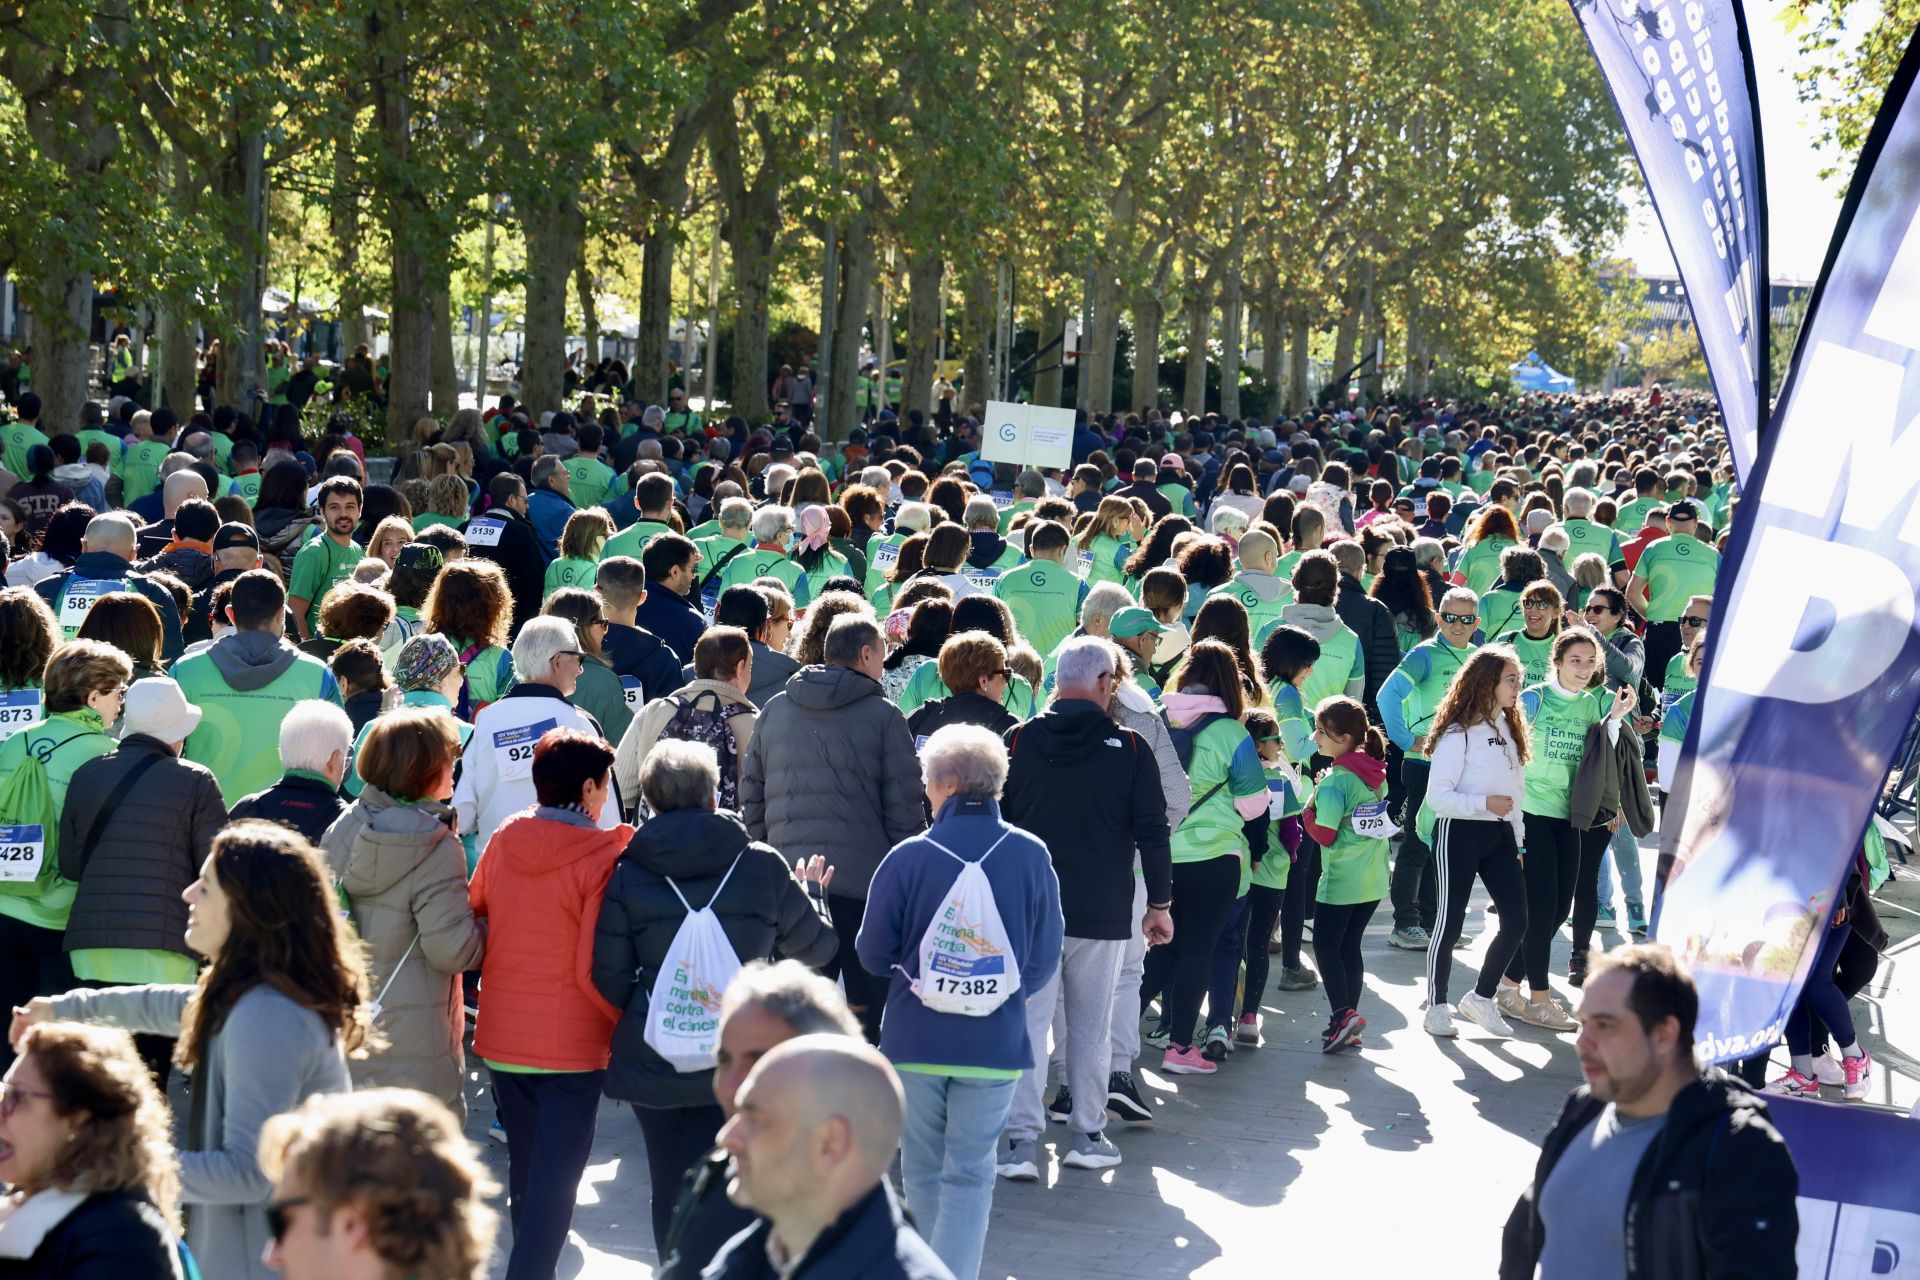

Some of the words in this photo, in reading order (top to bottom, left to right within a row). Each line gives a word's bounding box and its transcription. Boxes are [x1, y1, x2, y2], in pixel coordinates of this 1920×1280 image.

[472, 527, 495, 536] 5139
[1551, 727, 1566, 738] En
[1549, 740, 1582, 752] contra
[1548, 749, 1558, 759] el
[0, 846, 34, 861] 428
[936, 977, 998, 996] 17382
[662, 1016, 675, 1031] el
